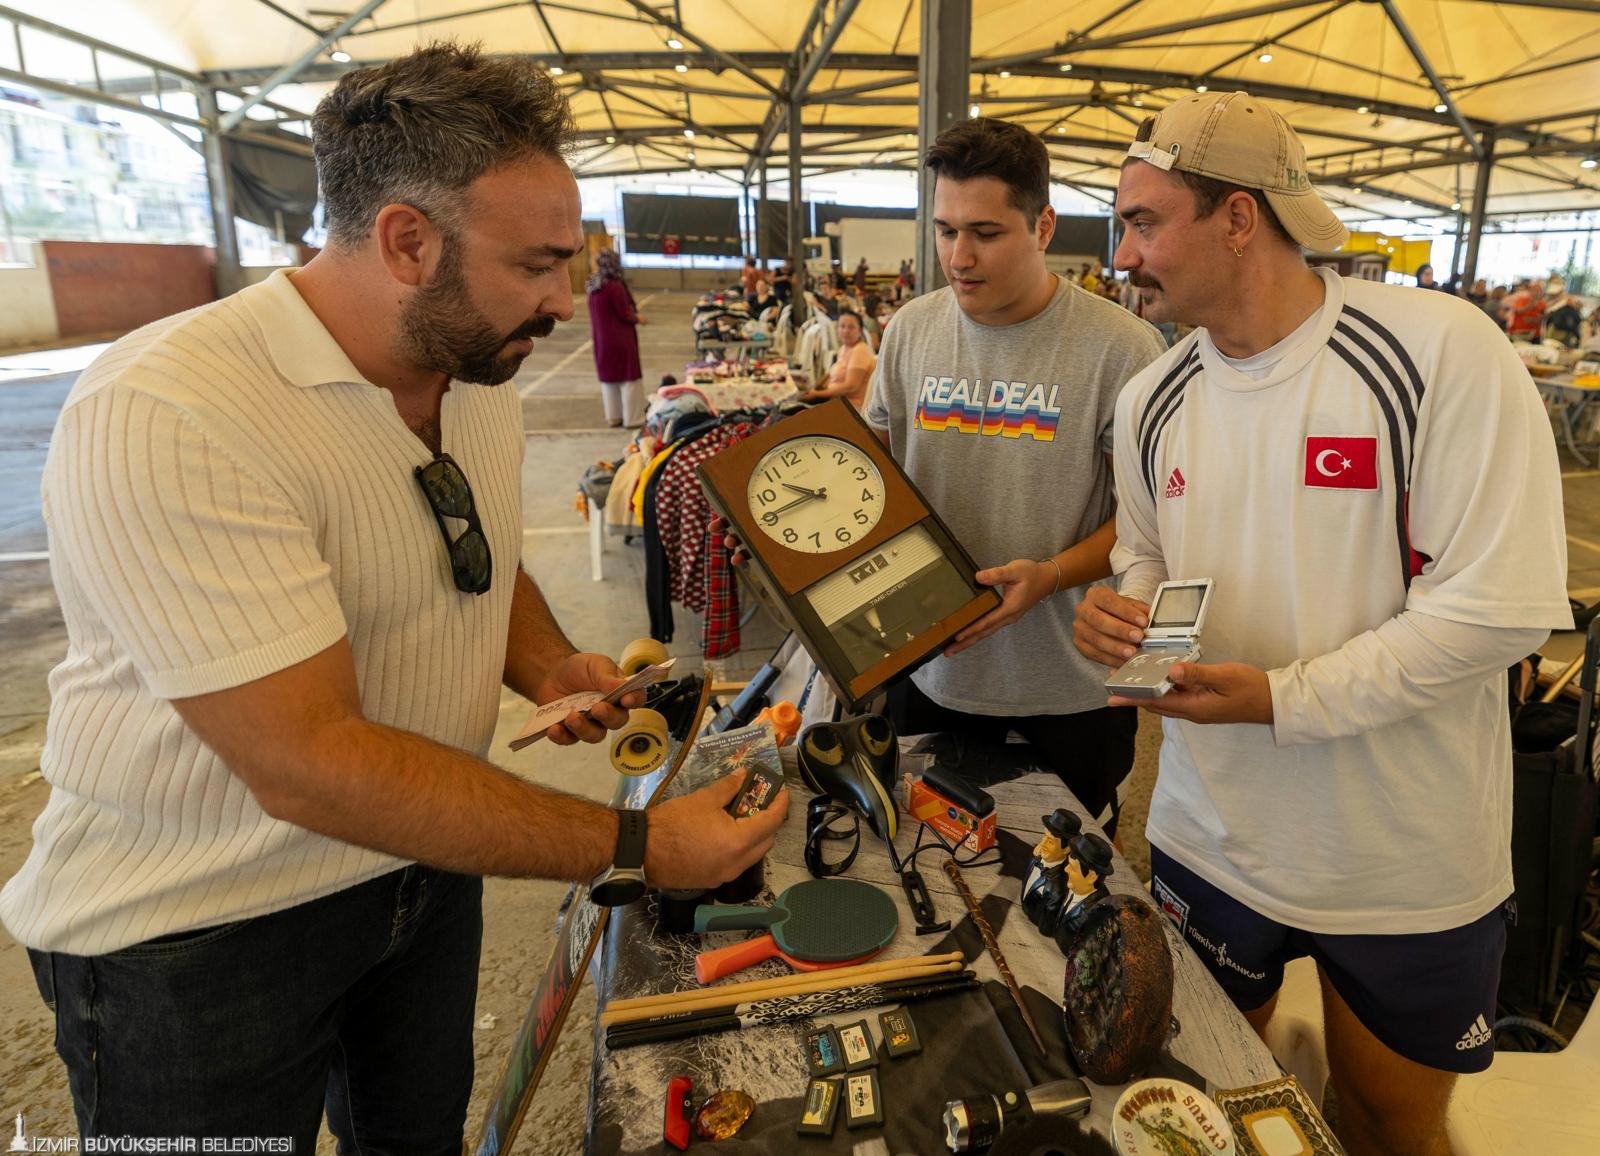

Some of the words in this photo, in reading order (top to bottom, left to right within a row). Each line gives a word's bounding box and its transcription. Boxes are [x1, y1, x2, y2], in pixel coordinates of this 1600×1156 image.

[917, 375, 983, 417] REAL
[985, 380, 1062, 423] DEAL
[781, 450, 802, 468] 12
[811, 448, 821, 460] 1
[832, 451, 848, 466] 2
[764, 466, 781, 483] 11
[852, 466, 868, 481] 3
[756, 488, 776, 506] 10
[861, 488, 874, 503] 4
[762, 511, 779, 527] 9
[853, 509, 869, 525] 5
[782, 527, 799, 544] 8
[807, 531, 822, 549] 7
[835, 527, 852, 542] 6
[535, 701, 565, 719] 200
[1188, 925, 1217, 955] TÜRKİYE
[1225, 957, 1266, 980] BANKASI
[1456, 1028, 1492, 1050] adidas
[1182, 1095, 1228, 1151] CYPRUS
